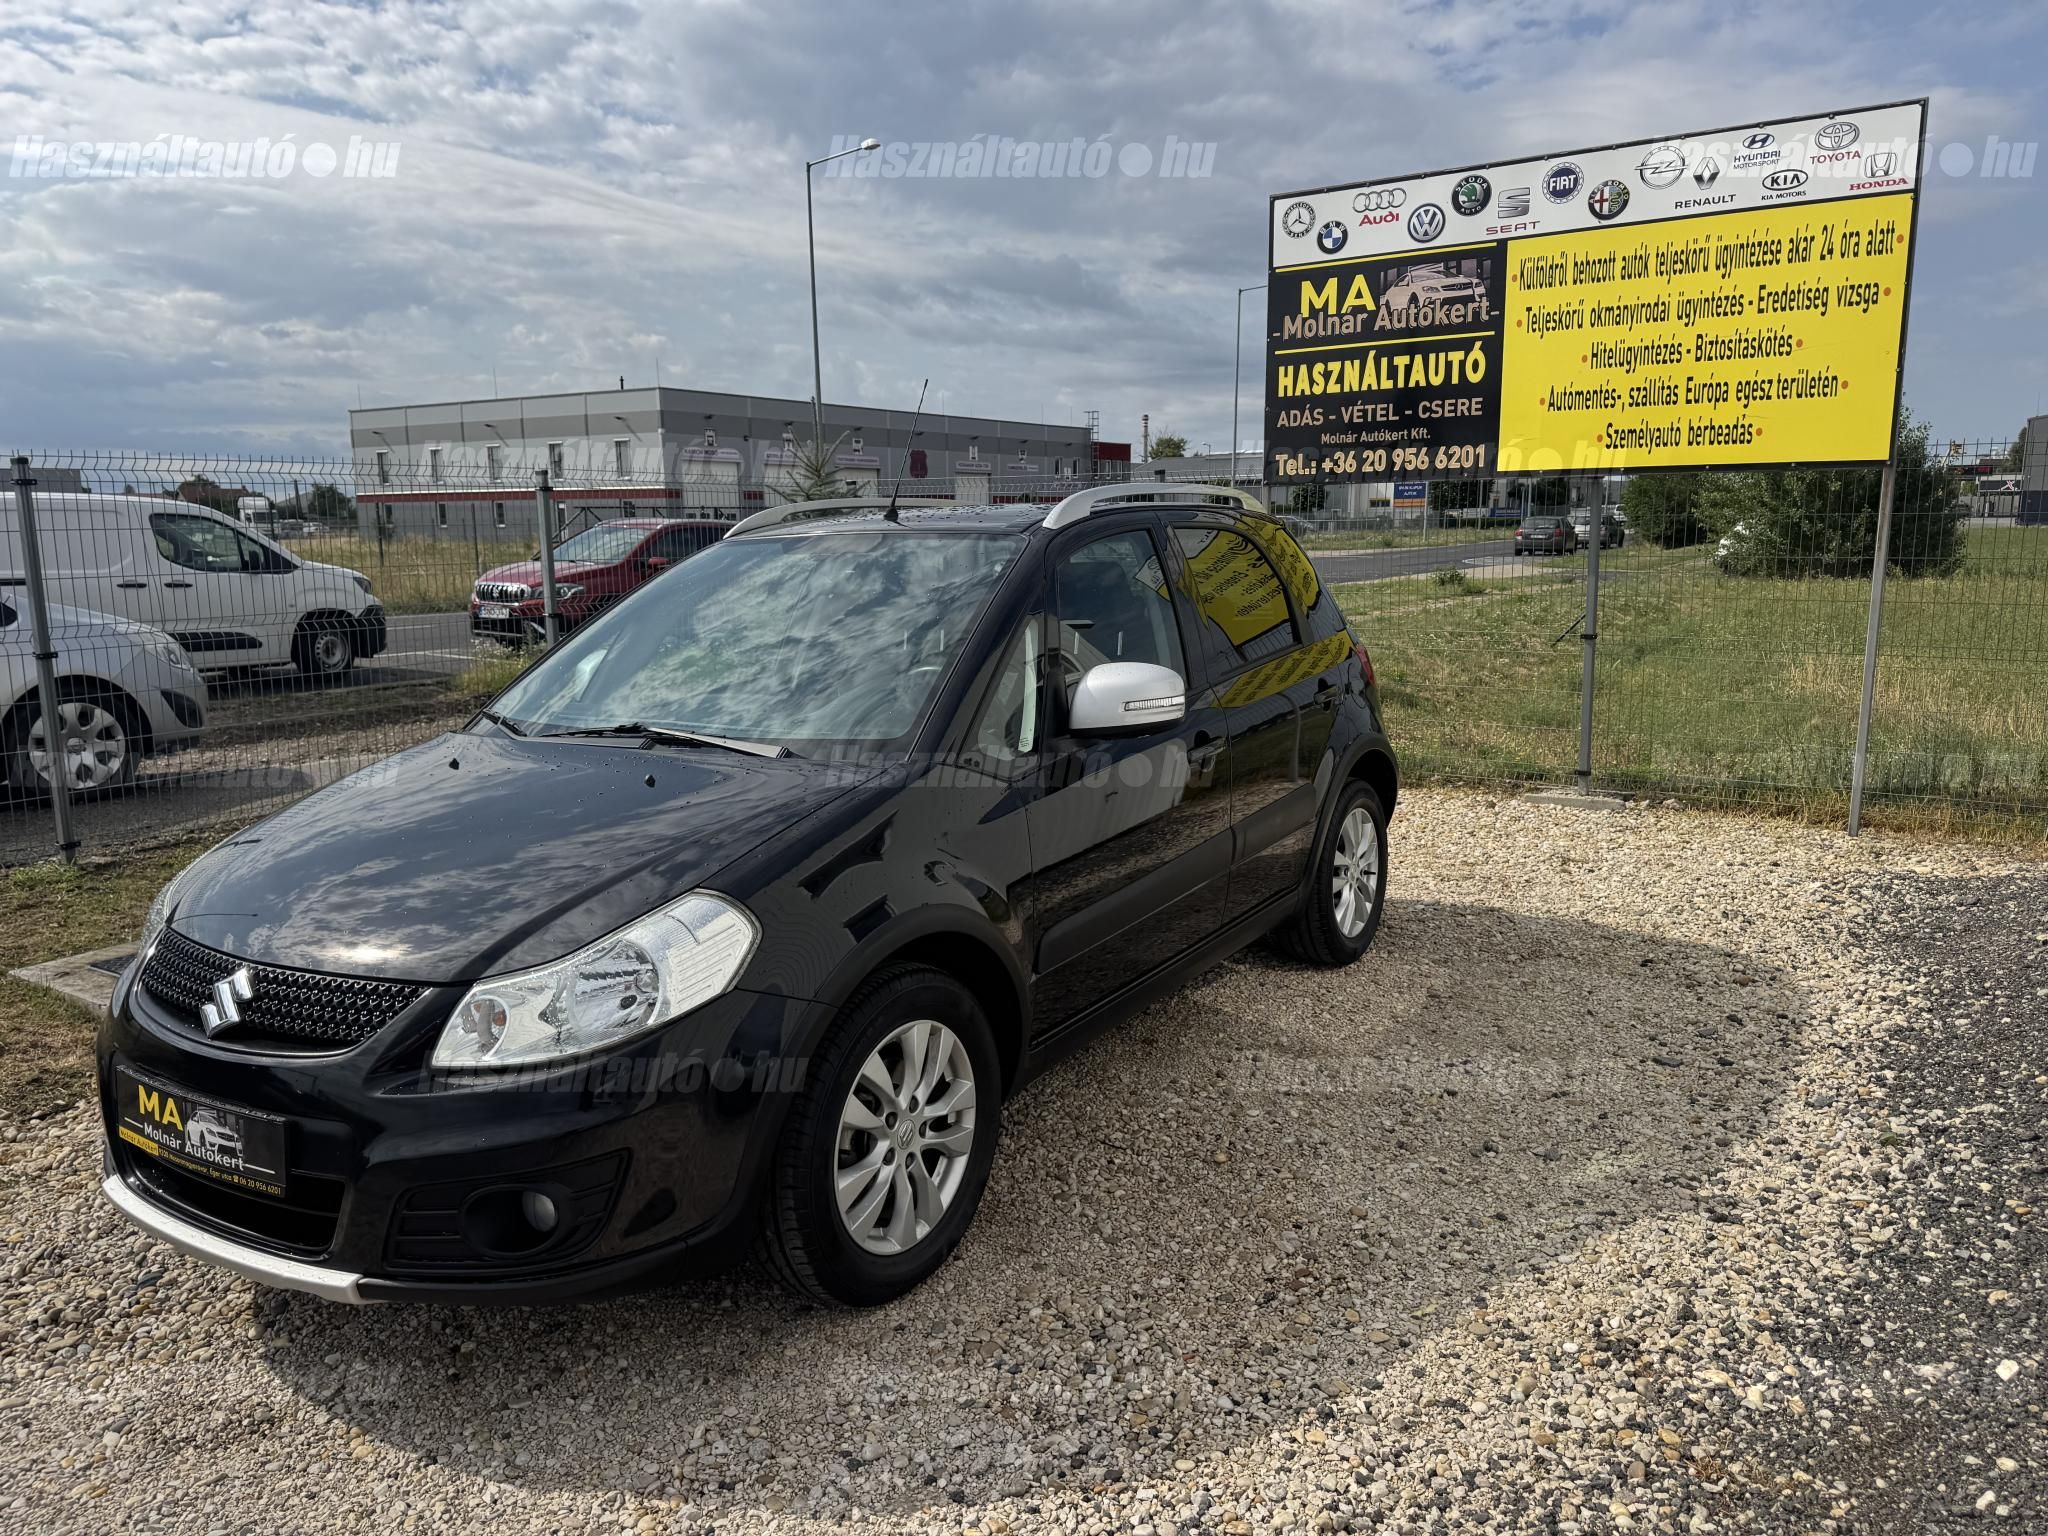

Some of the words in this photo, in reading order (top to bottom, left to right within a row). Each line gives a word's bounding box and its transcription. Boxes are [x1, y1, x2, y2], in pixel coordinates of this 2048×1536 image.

[1733, 159, 1780, 169] MOTORSPORT
[1734, 150, 1781, 163] HYUNDAI
[1810, 150, 1861, 165] TOYOTA
[1549, 174, 1576, 192] FIAT
[1770, 174, 1801, 187] KIA
[1849, 177, 1909, 191] HONDA
[1674, 194, 1736, 209] RENAULT
[1775, 190, 1807, 199] MOTORS
[1359, 211, 1400, 227] Audi
[1486, 220, 1541, 236] SEAT
[1519, 251, 1568, 291] Külföldről
[1572, 251, 1616, 286] behozott
[1620, 242, 1650, 281] autók
[1655, 234, 1711, 285] teljeskörű
[1715, 227, 1782, 280] ügyintézése
[1787, 223, 1815, 264] akár
[1819, 224, 1835, 261] 24
[1840, 219, 1861, 260] óra
[1866, 219, 1896, 257] alatt
[1300, 273, 1376, 318] MA
[1525, 299, 1585, 339] Teljeskörű
[1589, 293, 1671, 331] okmányirodai
[1677, 284, 1745, 327] ügyintézés
[1757, 277, 1829, 316] Eredetiség
[1837, 277, 1880, 314] vizsga
[1590, 333, 1683, 374] Hitelügyintézés
[1695, 324, 1793, 362] Biztosításkötés
[1277, 340, 1487, 398] HASZNÁLTAUTÓ
[1629, 375, 1679, 407] szállítás
[1685, 373, 1729, 410] Európa
[1735, 369, 1774, 409] egész
[1776, 365, 1838, 400] területén
[1277, 404, 1324, 428] ADÁS
[1341, 401, 1400, 424] VÉTEL
[1418, 397, 1484, 419] CSERE
[1321, 431, 1358, 444] Molnár
[1360, 428, 1408, 443] Autókert
[1411, 427, 1431, 440] Kft.
[1605, 417, 1681, 455] Személyautó
[1687, 414, 1753, 446] bérbeadás
[1275, 453, 1317, 476] Tel.:
[1322, 451, 1357, 473] +36
[1362, 450, 1386, 472] 20
[1391, 447, 1430, 471] 956
[1434, 444, 1486, 470] 6201
[138, 1084, 184, 1132] MA
[144, 1122, 182, 1149] Molnár
